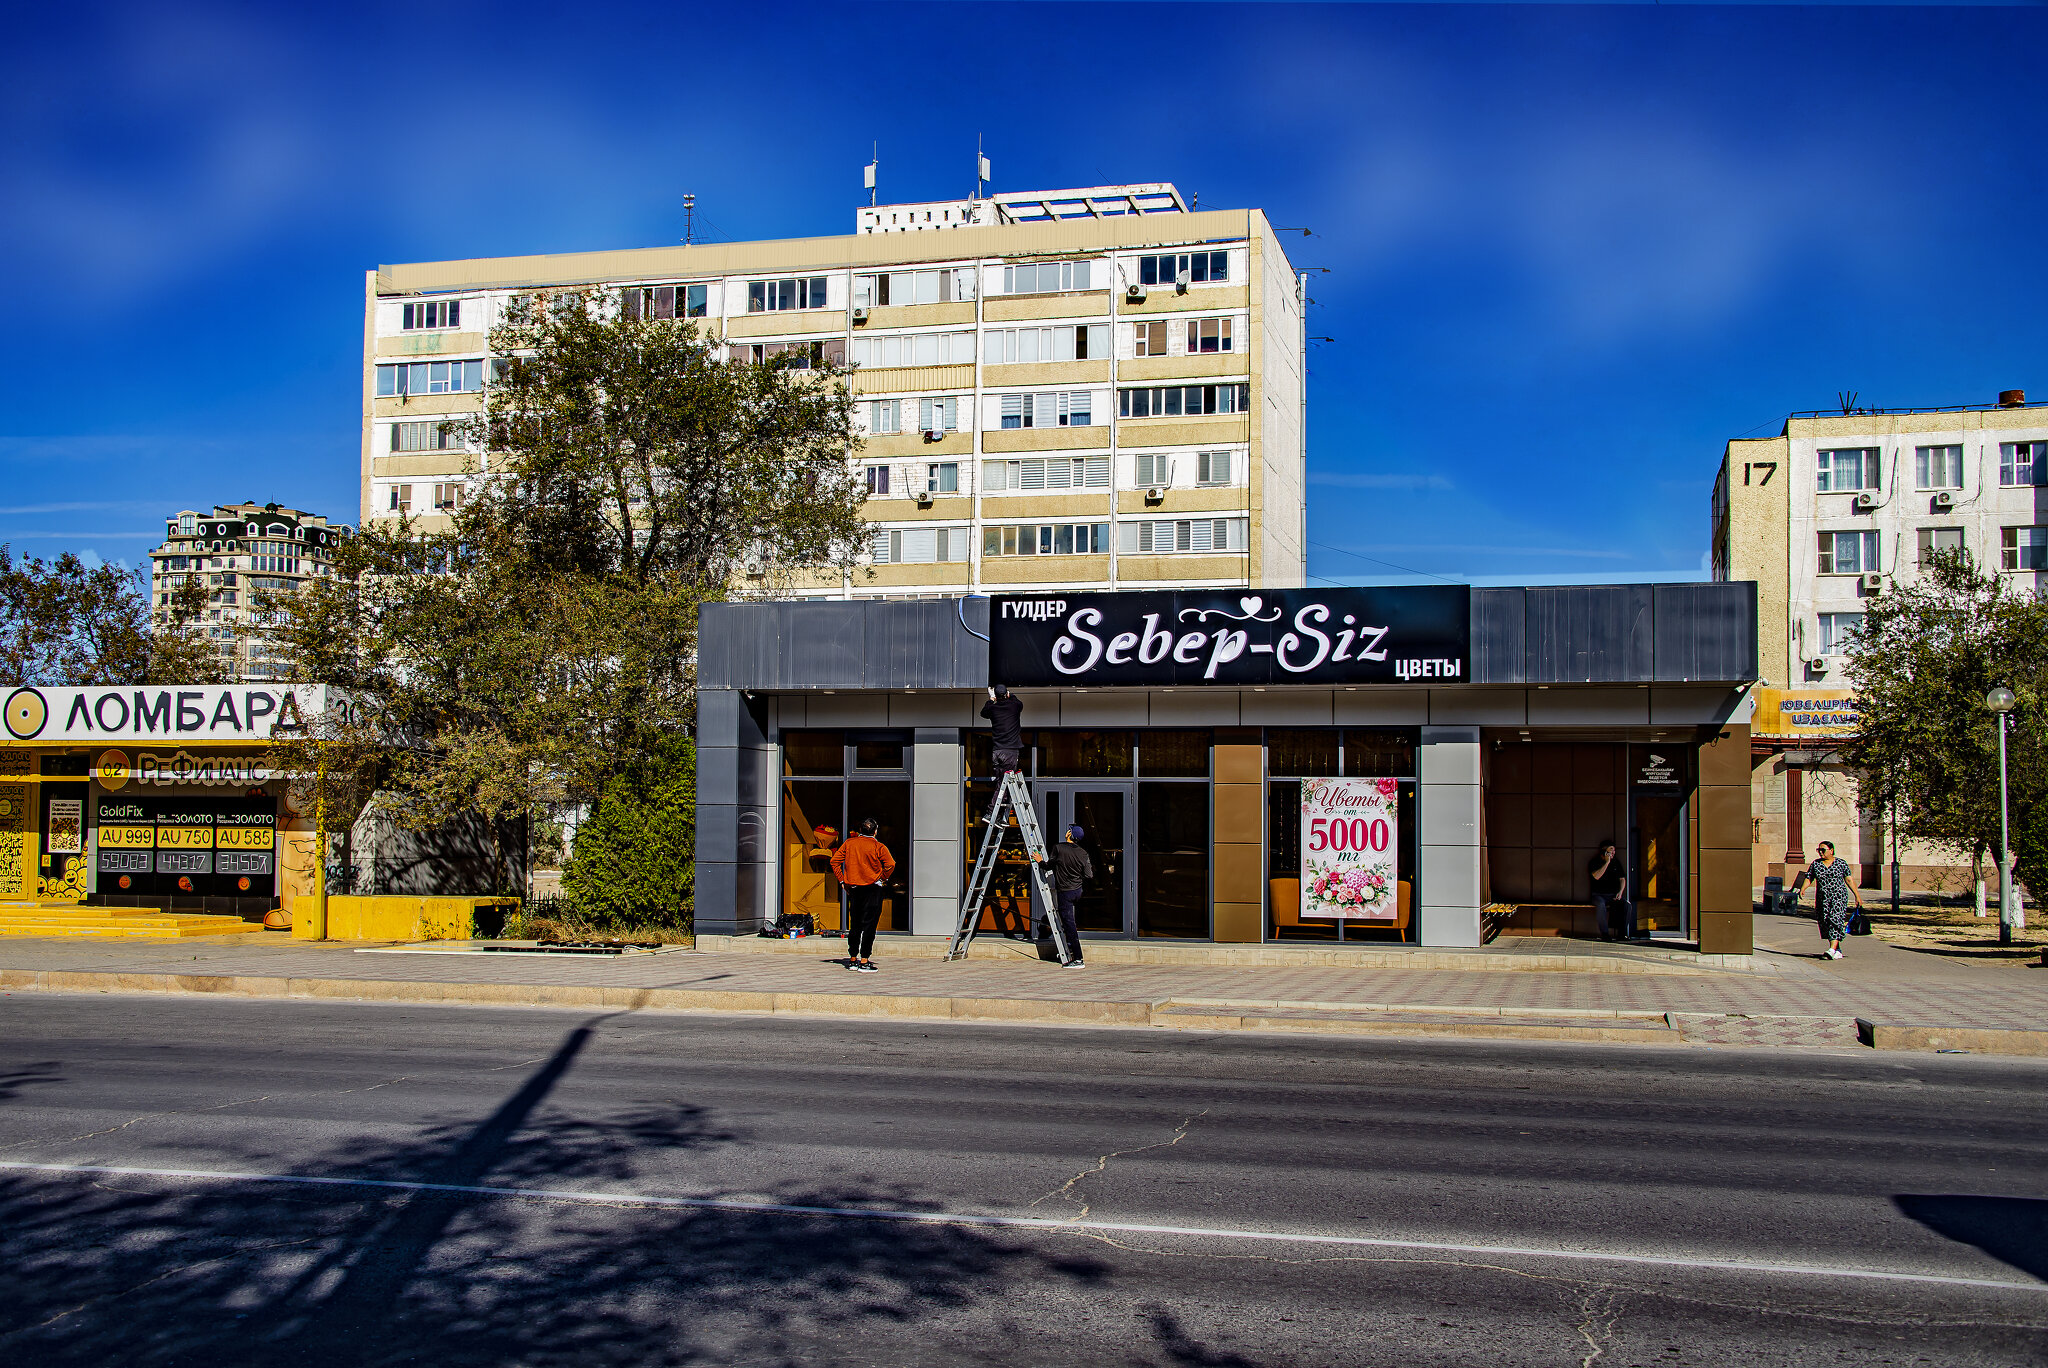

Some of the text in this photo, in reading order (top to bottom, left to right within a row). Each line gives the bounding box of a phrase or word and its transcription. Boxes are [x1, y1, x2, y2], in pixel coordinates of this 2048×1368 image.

[1744, 462, 1777, 486] 17
[1002, 600, 1067, 621] ГҮЛДЕР
[1395, 658, 1461, 681] ЦВЕТЫ
[66, 690, 308, 735] ЛОМБАРД
[1314, 786, 1383, 814] Цветы
[101, 829, 151, 844] AU 999
[160, 829, 211, 844] AU 750
[219, 830, 271, 845] AU 585
[1308, 818, 1389, 851] 5000
[101, 853, 148, 869] 59083
[162, 854, 206, 870] 44317
[1337, 852, 1360, 861] тг
